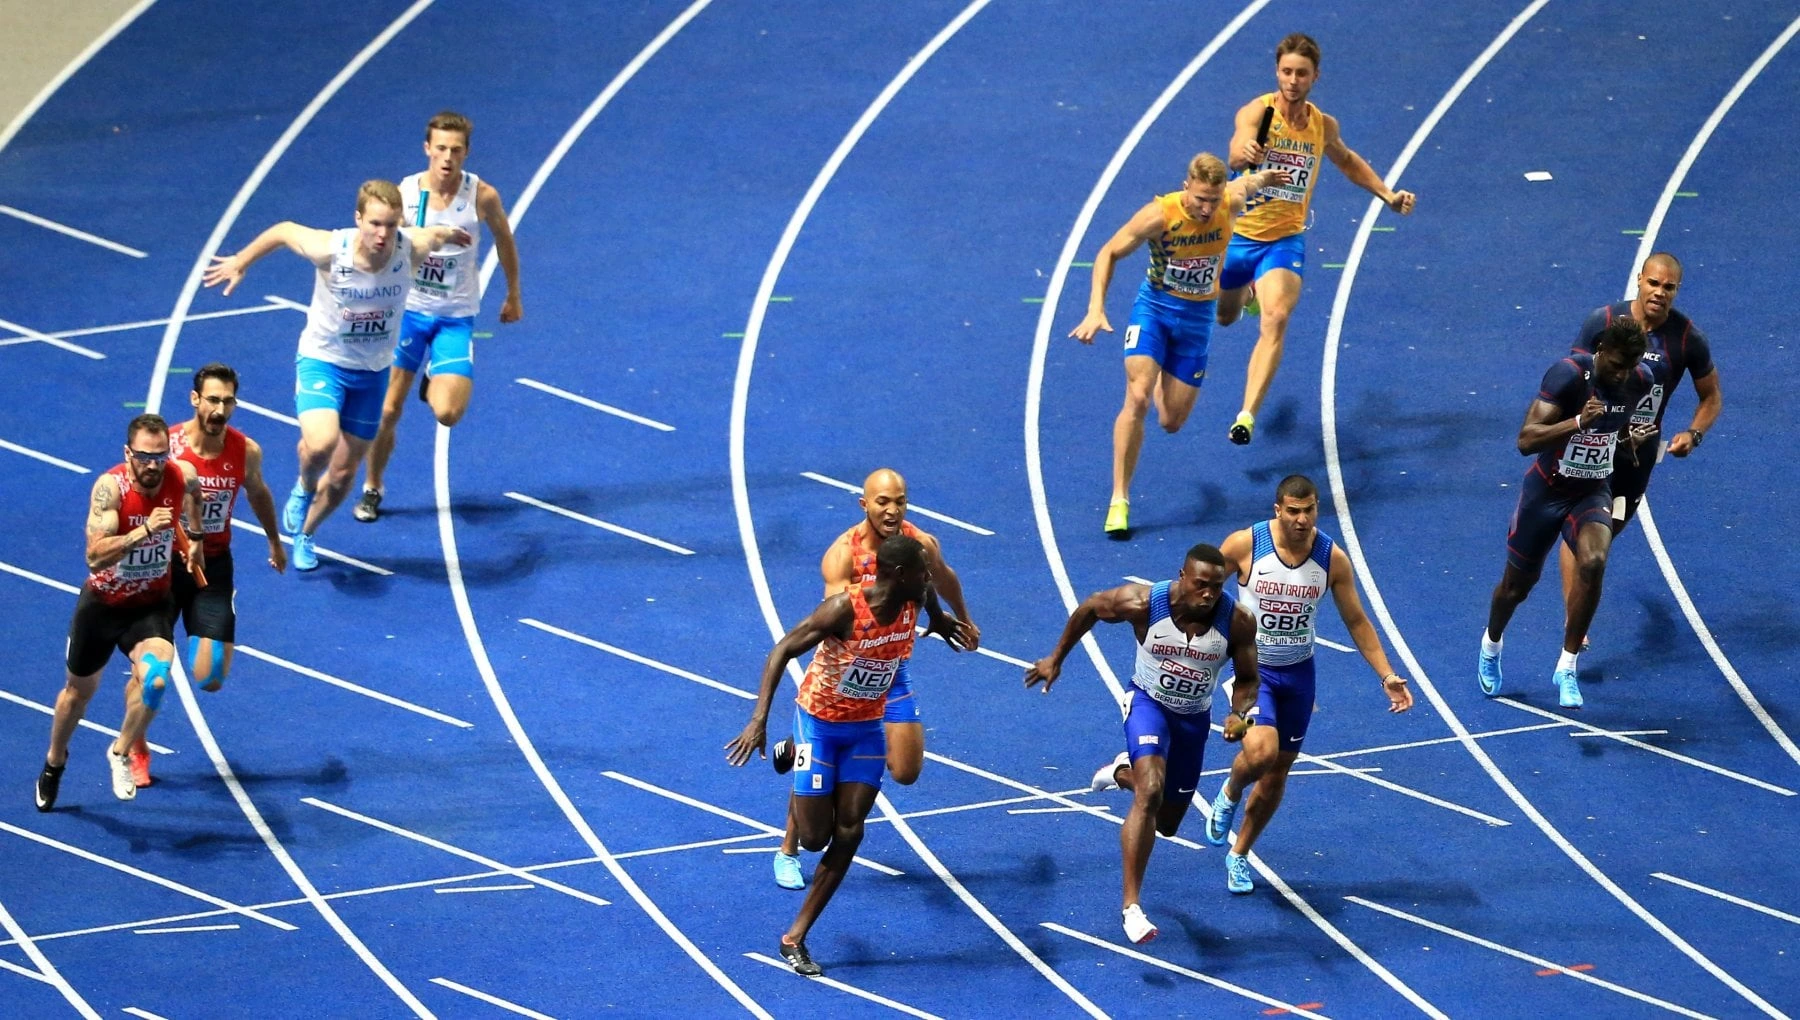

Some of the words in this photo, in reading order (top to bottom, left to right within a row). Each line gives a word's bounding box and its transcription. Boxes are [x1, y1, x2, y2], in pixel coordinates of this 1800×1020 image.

[1273, 136, 1315, 154] UKRAINE
[1268, 152, 1305, 167] SPAR
[1262, 187, 1289, 199] BERLIN
[1171, 228, 1223, 247] UKRAINE
[1170, 267, 1214, 284] UKR
[341, 284, 402, 300] FINLAND
[350, 320, 387, 333] FIN
[1631, 415, 1650, 424] 2018
[1571, 435, 1609, 446] SPAR
[1570, 445, 1610, 465] FRA
[1565, 467, 1593, 478] BERLIN
[198, 475, 236, 488] RKİYE
[128, 545, 167, 565] TUR
[123, 569, 151, 579] BERLIN
[1255, 580, 1286, 596] GREAT
[1286, 584, 1320, 599] BRITAIN
[1260, 600, 1302, 612] SPAR
[1260, 613, 1310, 631] GBR
[1260, 635, 1288, 645] BERLIN
[1289, 635, 1307, 645] 2018
[1151, 643, 1185, 656] GREAT
[1184, 646, 1221, 661] BRITAIN
[853, 659, 893, 671] SPAR
[1161, 660, 1204, 682] SPAR
[848, 668, 893, 687] NED
[1159, 673, 1210, 696] GBR
[841, 687, 869, 698] BERLIN
[1154, 691, 1184, 705] BERLIN
[797, 749, 805, 767] 6
